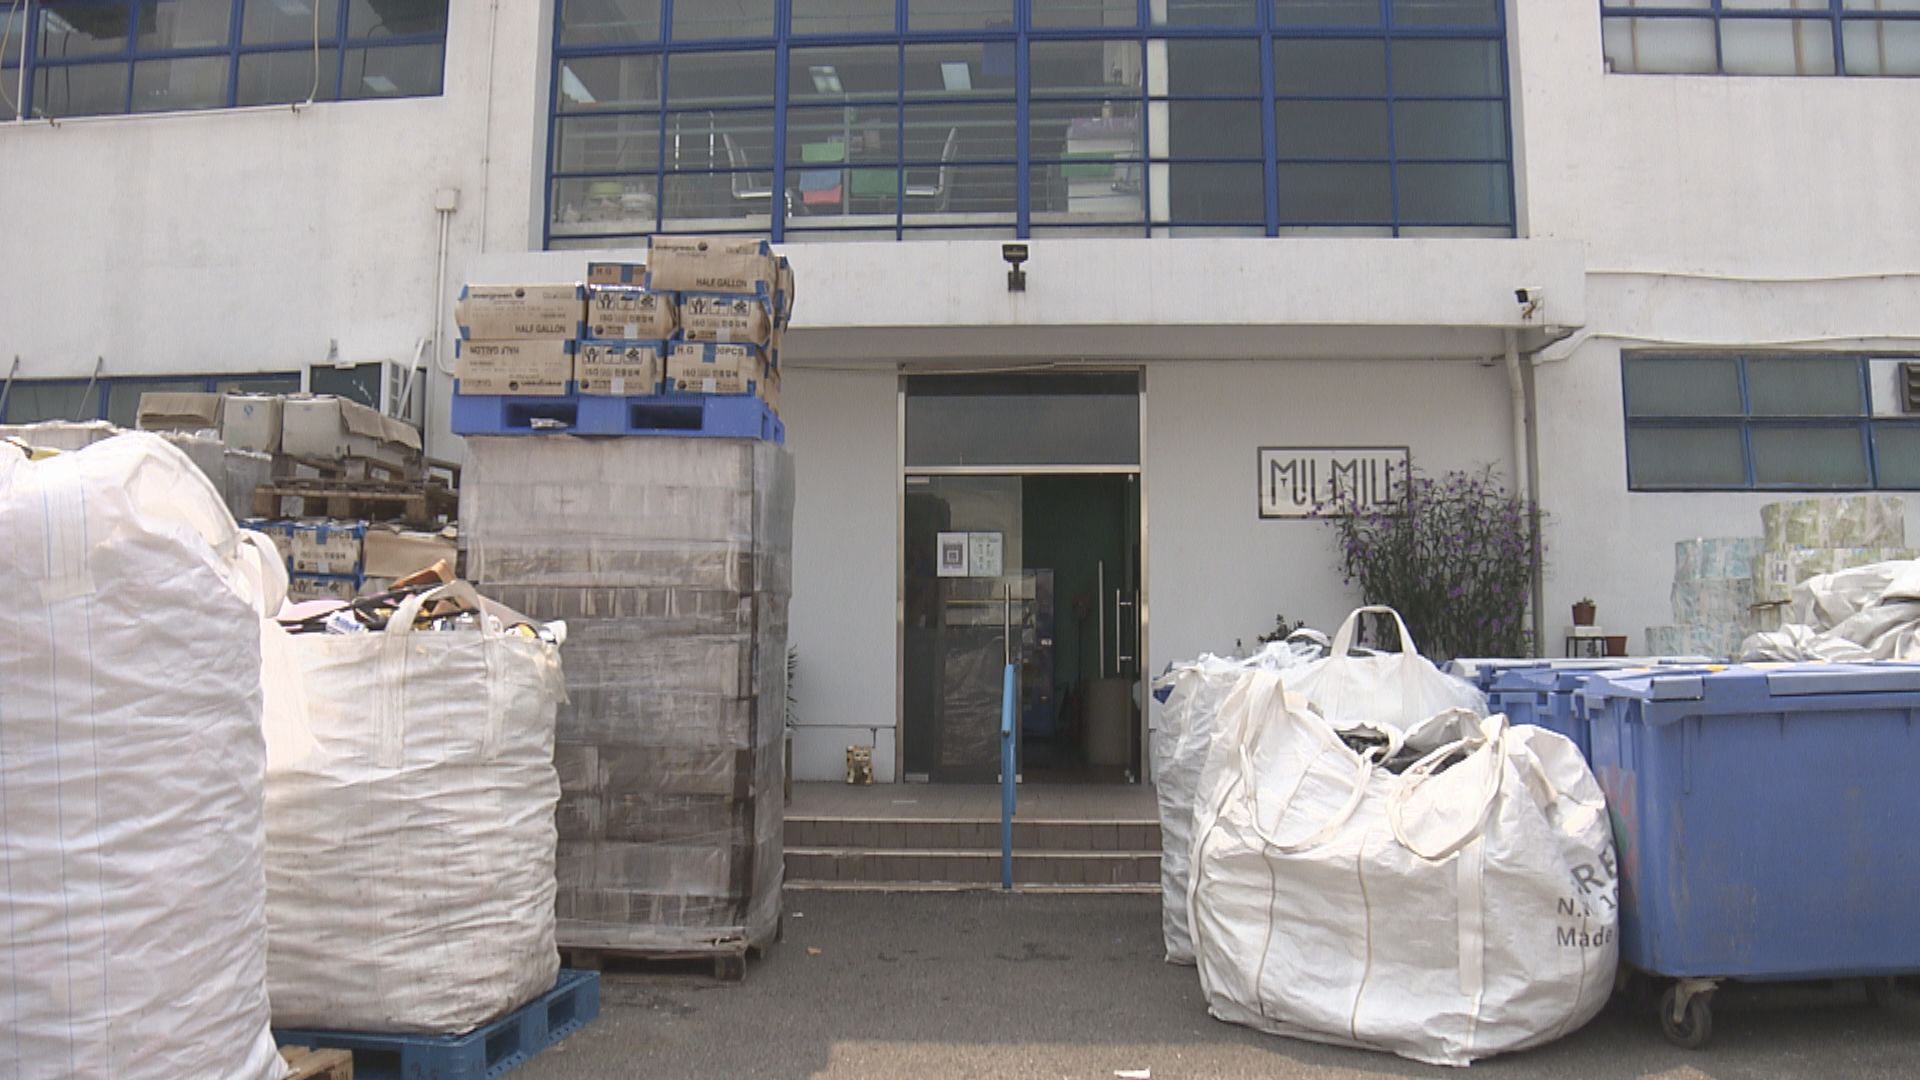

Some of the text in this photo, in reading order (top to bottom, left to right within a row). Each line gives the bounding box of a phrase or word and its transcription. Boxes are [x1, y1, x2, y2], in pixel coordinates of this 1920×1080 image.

[696, 277, 748, 288] HALF GALLON
[515, 324, 566, 334] HALF GALLON
[469, 346, 520, 355] HALF GALLON
[1556, 926, 1613, 948] Made
